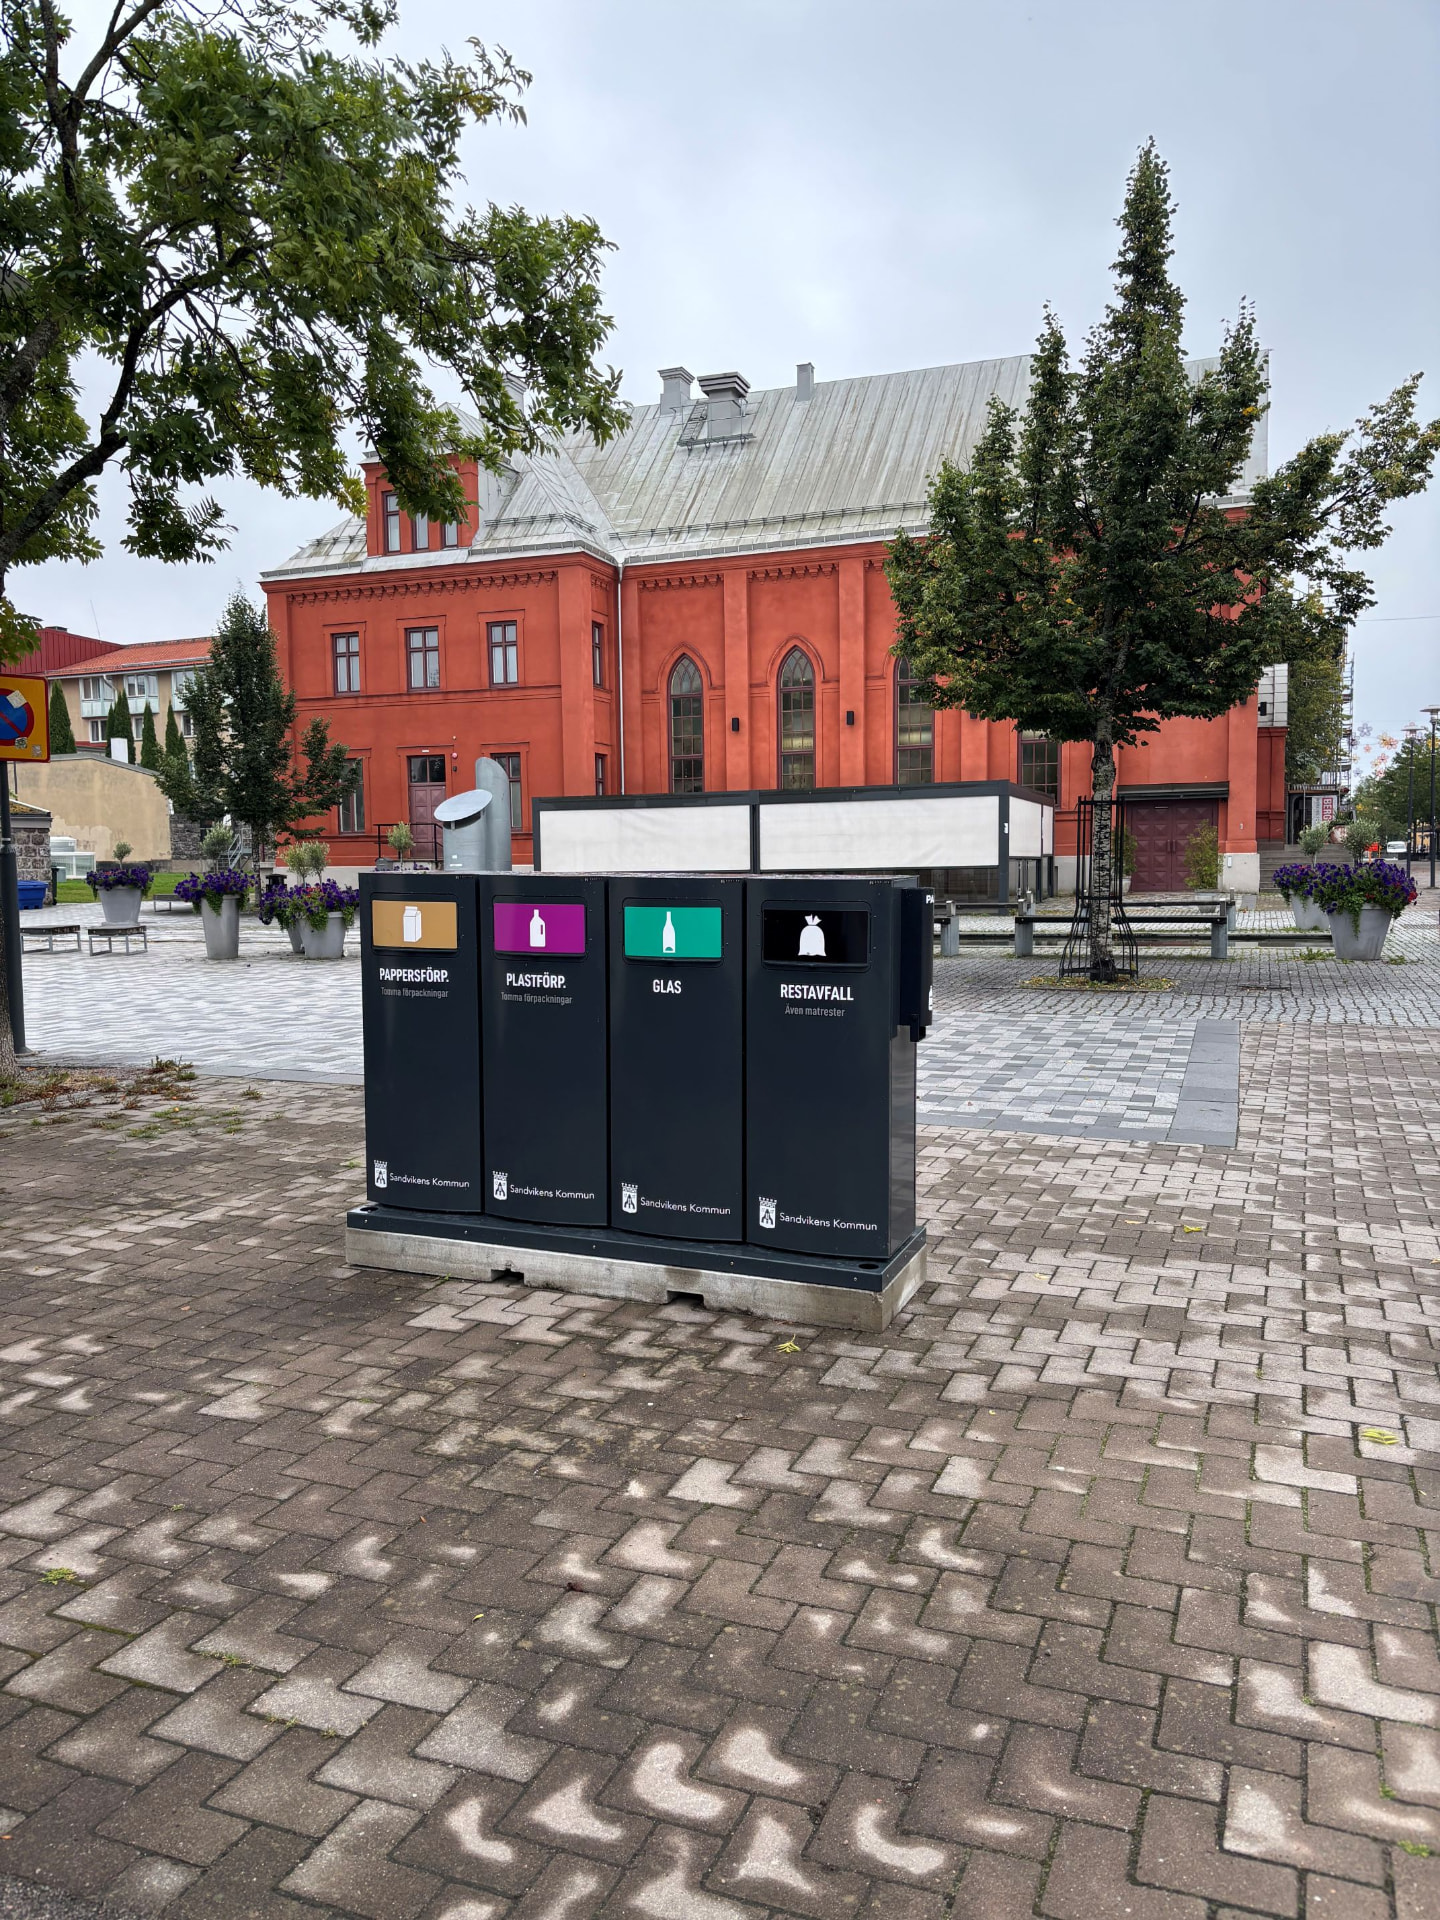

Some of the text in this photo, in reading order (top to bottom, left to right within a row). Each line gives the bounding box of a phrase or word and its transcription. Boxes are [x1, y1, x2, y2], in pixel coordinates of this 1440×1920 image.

[379, 966, 450, 983] PAPPERSFÖRP.
[506, 971, 567, 989] PLASTFÖRP.
[380, 986, 449, 998] Tomma förpackningar
[652, 979, 682, 995] GLAS
[780, 983, 855, 1001] RESTAVFALL
[501, 991, 573, 1005] Tomma förpackningar
[785, 1002, 846, 1018] Även matrester
[389, 1173, 470, 1188] Sandvikens Kommun
[510, 1184, 595, 1200] Sandvikens Kommun
[640, 1197, 731, 1215] Sandvikens Kommun
[779, 1212, 878, 1231] Sandvikens Kommun
